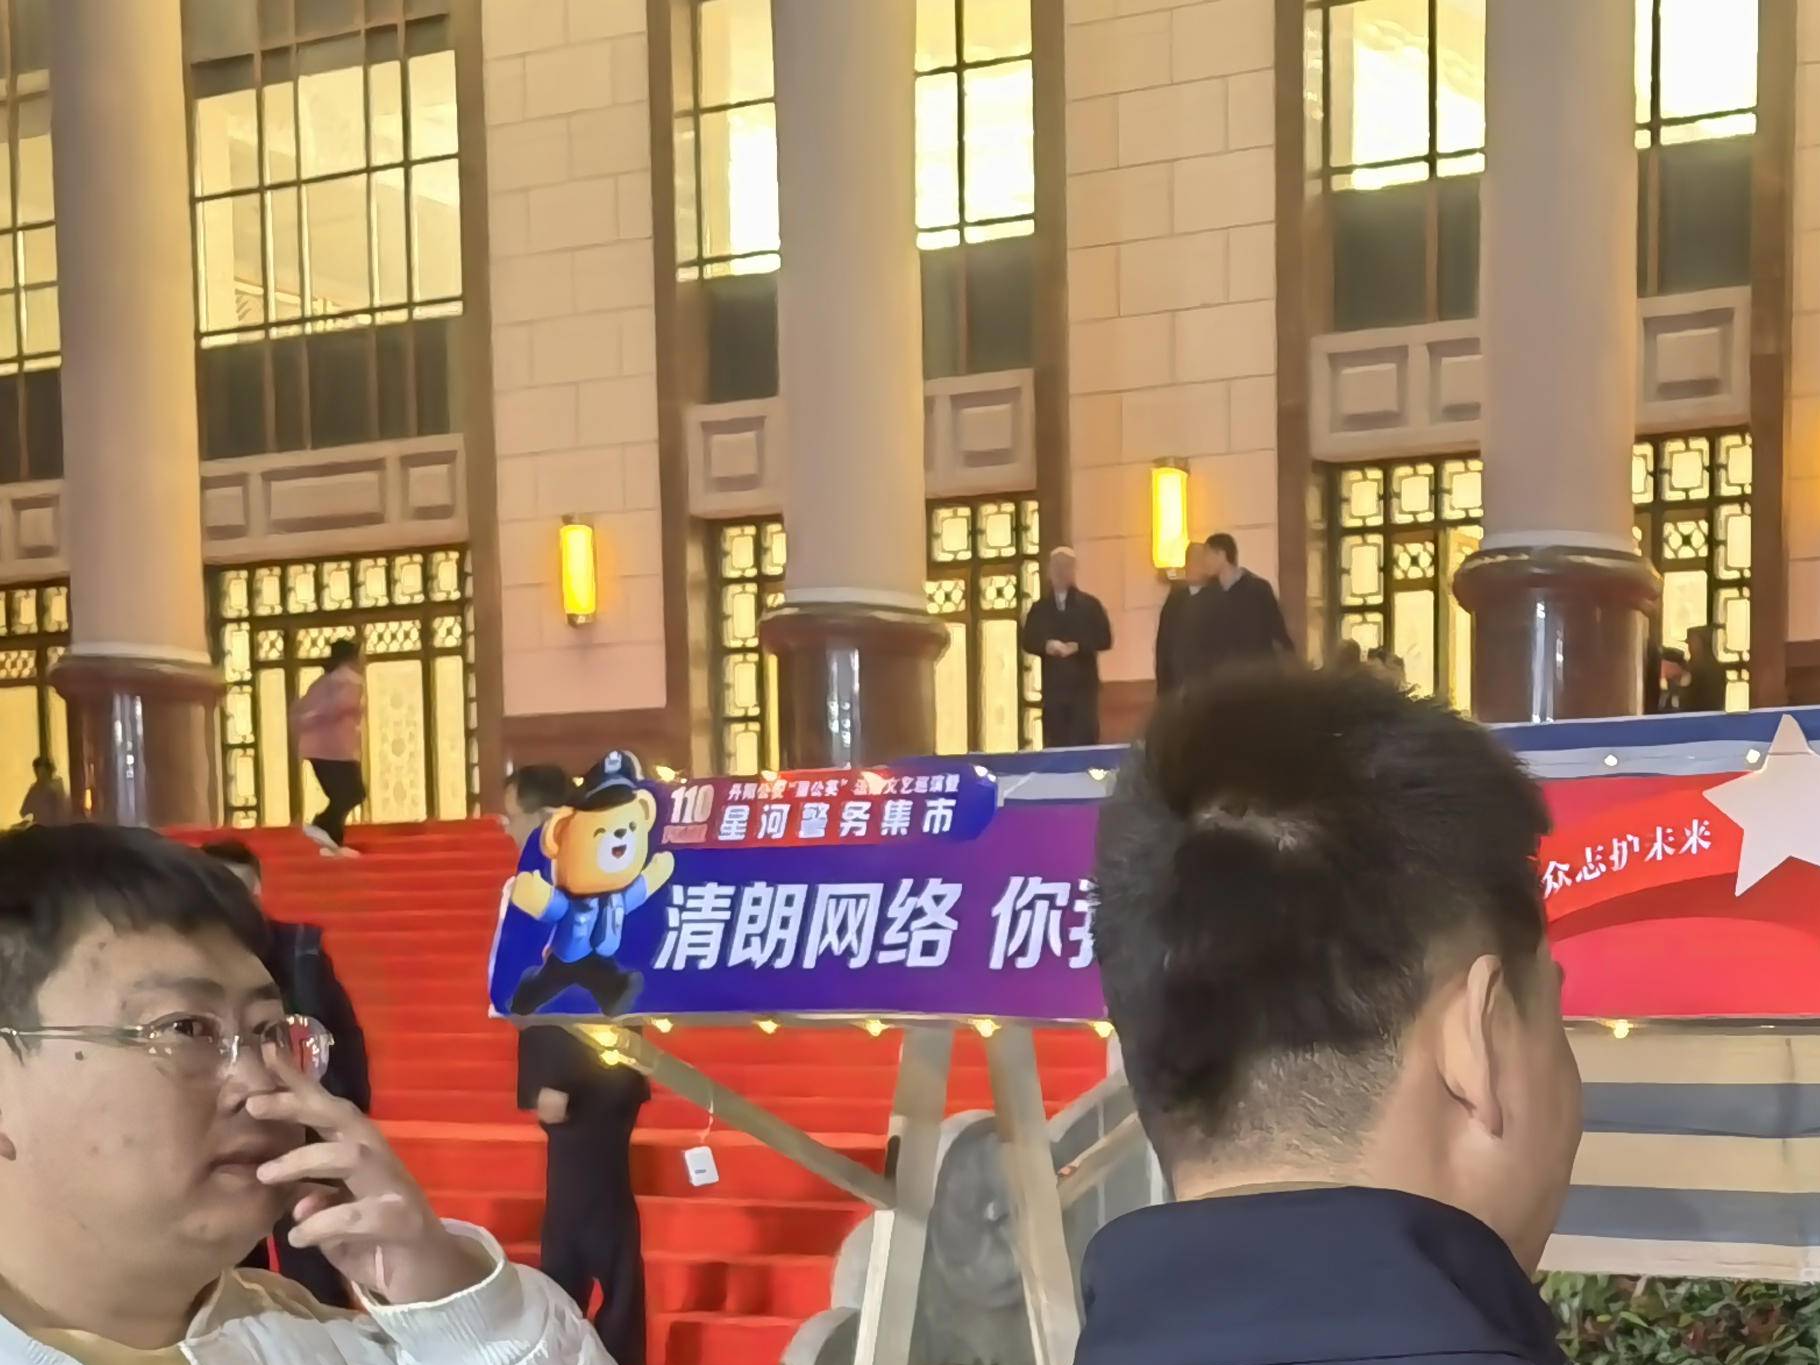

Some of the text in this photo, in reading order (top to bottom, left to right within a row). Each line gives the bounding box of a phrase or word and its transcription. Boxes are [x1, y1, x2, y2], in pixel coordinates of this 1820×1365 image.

[670, 783, 715, 825] 110
[717, 798, 958, 842] 星河警务集市
[652, 876, 963, 971] 清朗网络
